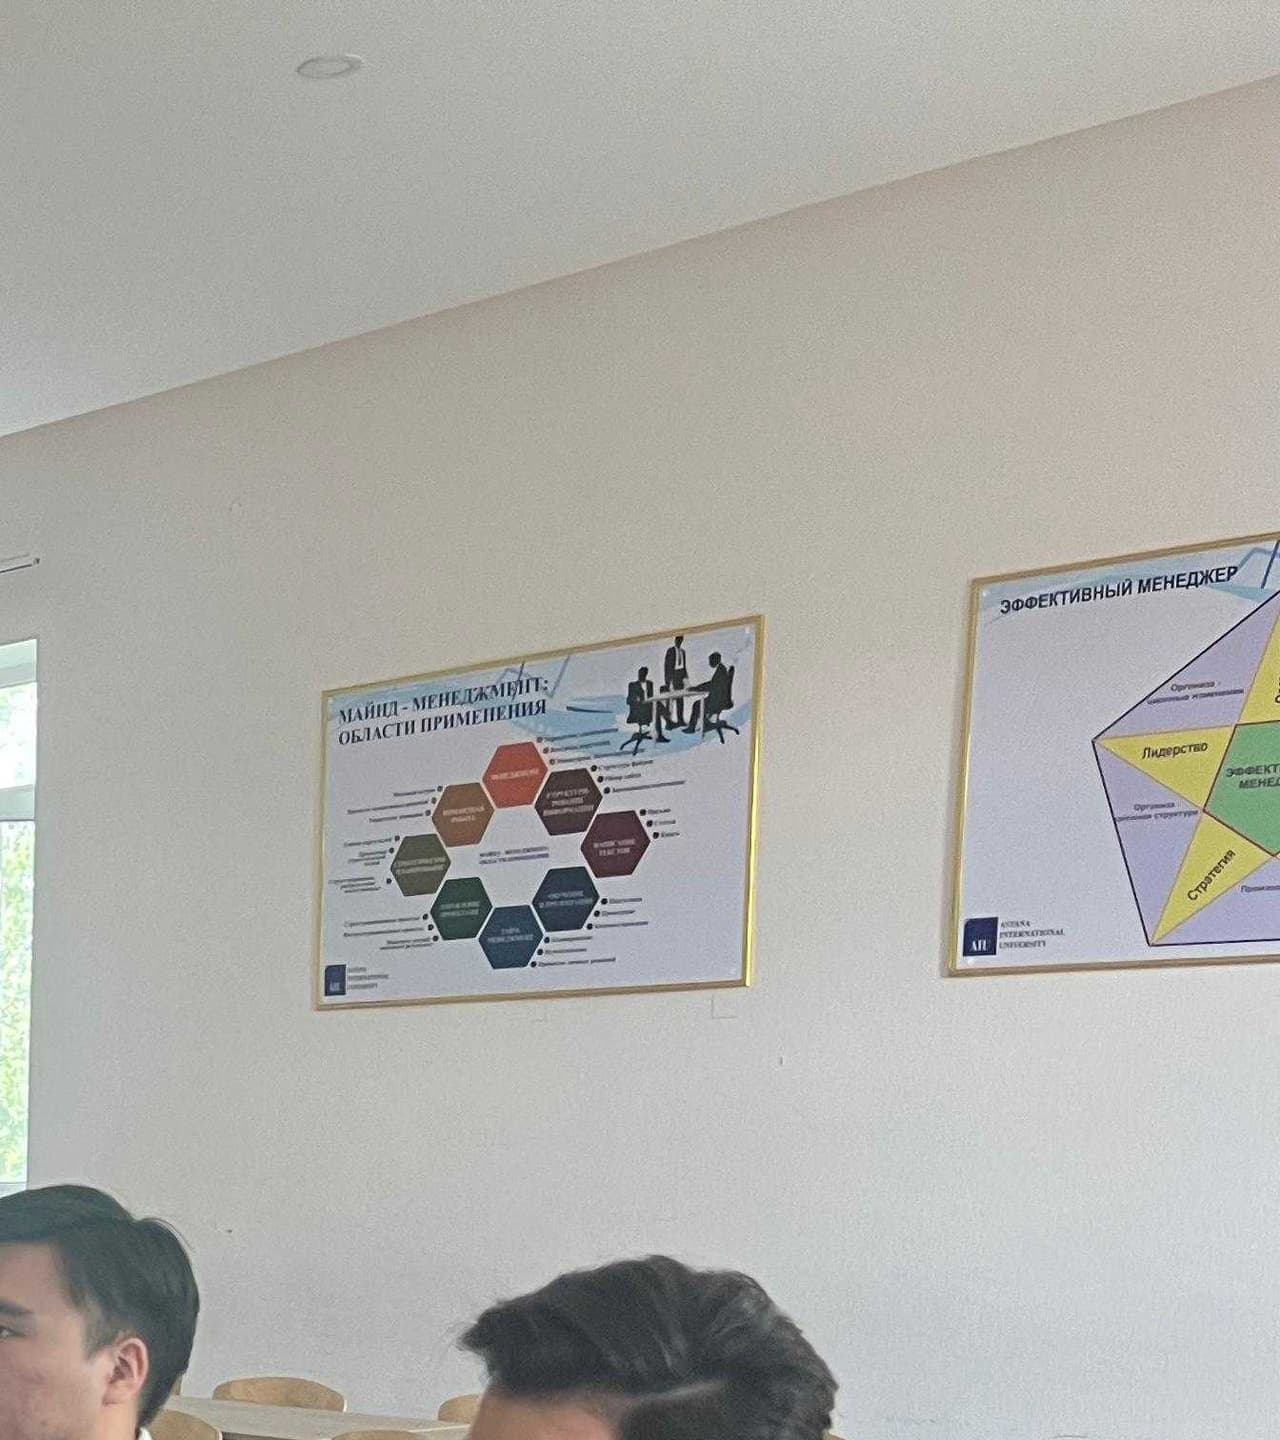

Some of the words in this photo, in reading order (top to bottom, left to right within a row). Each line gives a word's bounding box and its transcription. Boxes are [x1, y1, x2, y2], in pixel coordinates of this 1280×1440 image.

[1000, 578, 1132, 615] ЭФФЕКТИВНЫЙ
[1137, 566, 1238, 595] МЕНЕДЖЕР
[339, 700, 399, 725] МАЙНД
[339, 720, 416, 745] ОБЛАСТИ
[421, 700, 547, 733] ПРИМЕНЕНИЯ
[1142, 742, 1208, 760] Лидерство
[1225, 763, 1280, 778] ЭФФЕКТ
[1187, 849, 1237, 901] Стратегия
